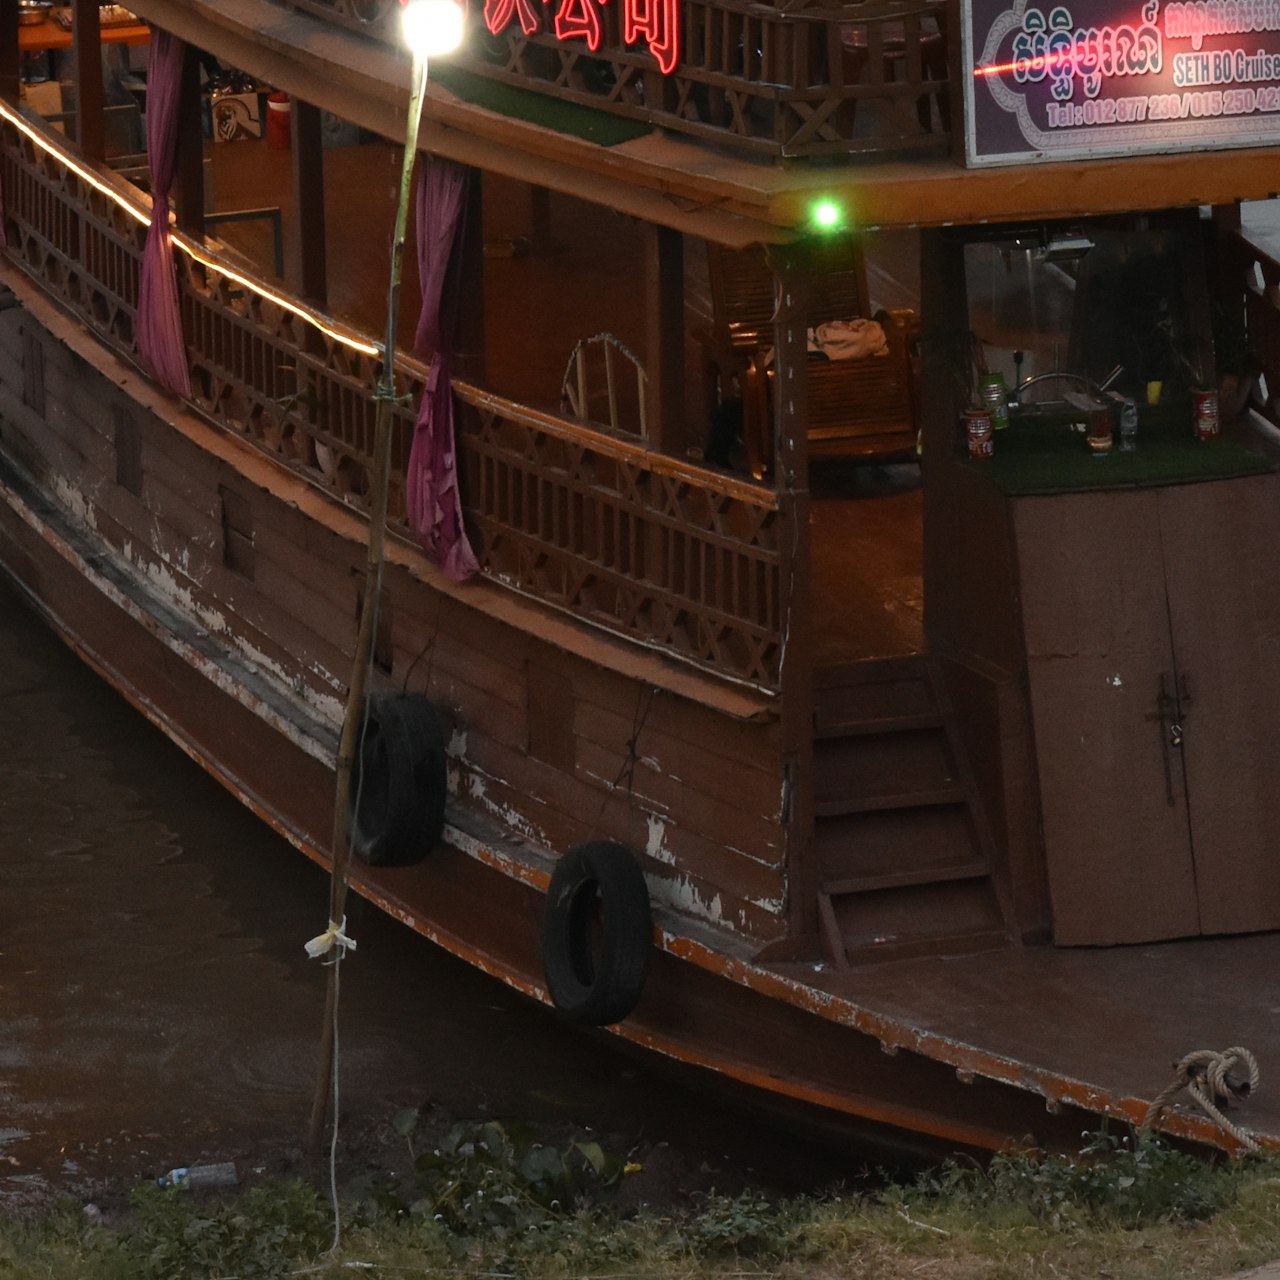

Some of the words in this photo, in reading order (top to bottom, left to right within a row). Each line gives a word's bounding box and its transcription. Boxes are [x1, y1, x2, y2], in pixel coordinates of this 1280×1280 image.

[1175, 56, 1210, 85] SETH
[1214, 56, 1233, 82] BO
[1084, 99, 1115, 124] 012
[1117, 97, 1148, 121] 877
[1191, 91, 1222, 116] 015
[1224, 89, 1255, 113] 250
